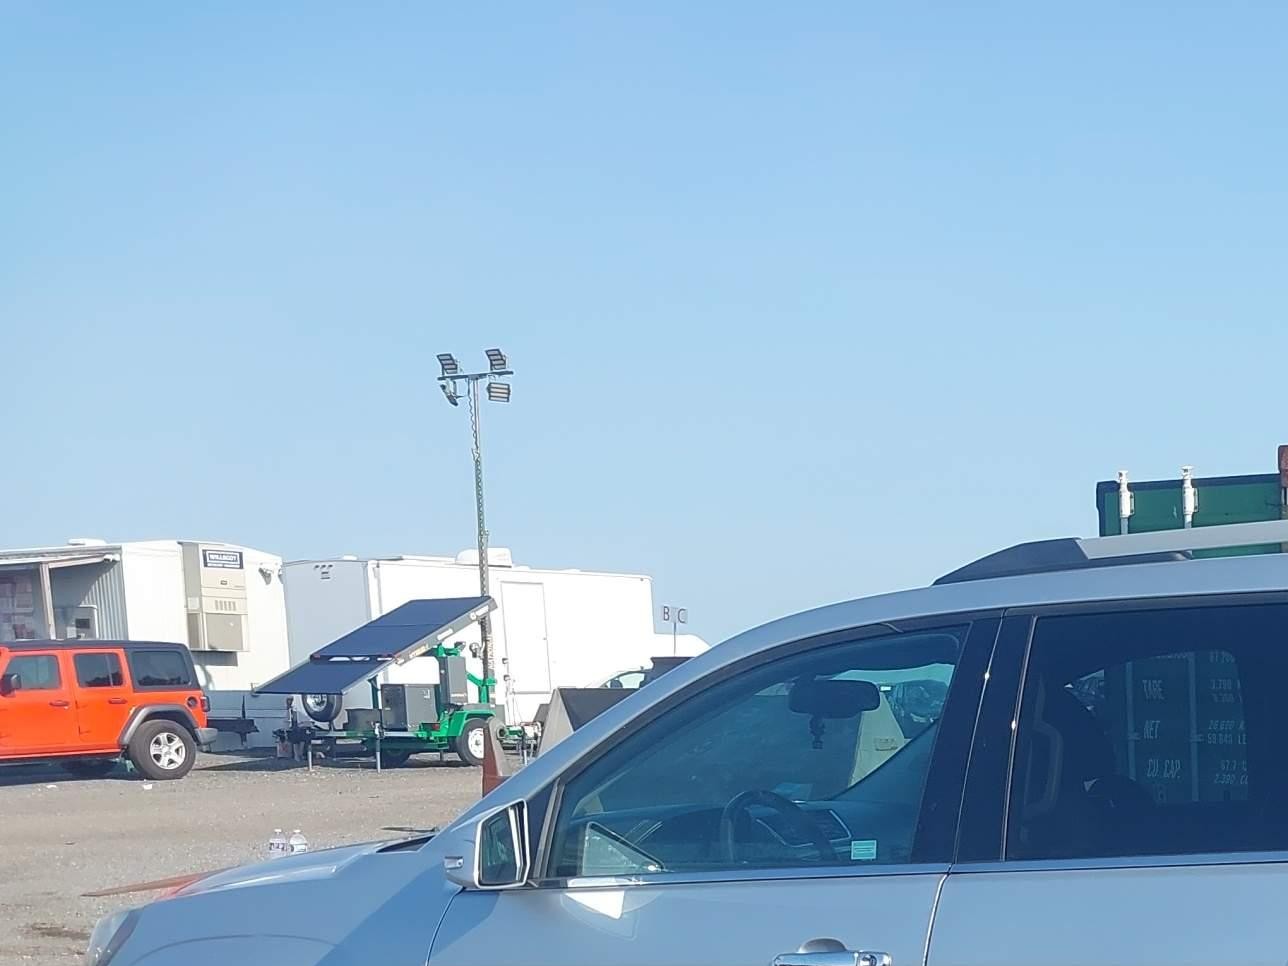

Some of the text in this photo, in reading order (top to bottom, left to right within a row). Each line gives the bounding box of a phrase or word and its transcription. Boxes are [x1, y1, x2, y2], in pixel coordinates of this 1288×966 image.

[663, 606, 670, 621] B
[677, 608, 686, 623] C
[1142, 679, 1165, 700] TARE
[1143, 720, 1160, 739] NET
